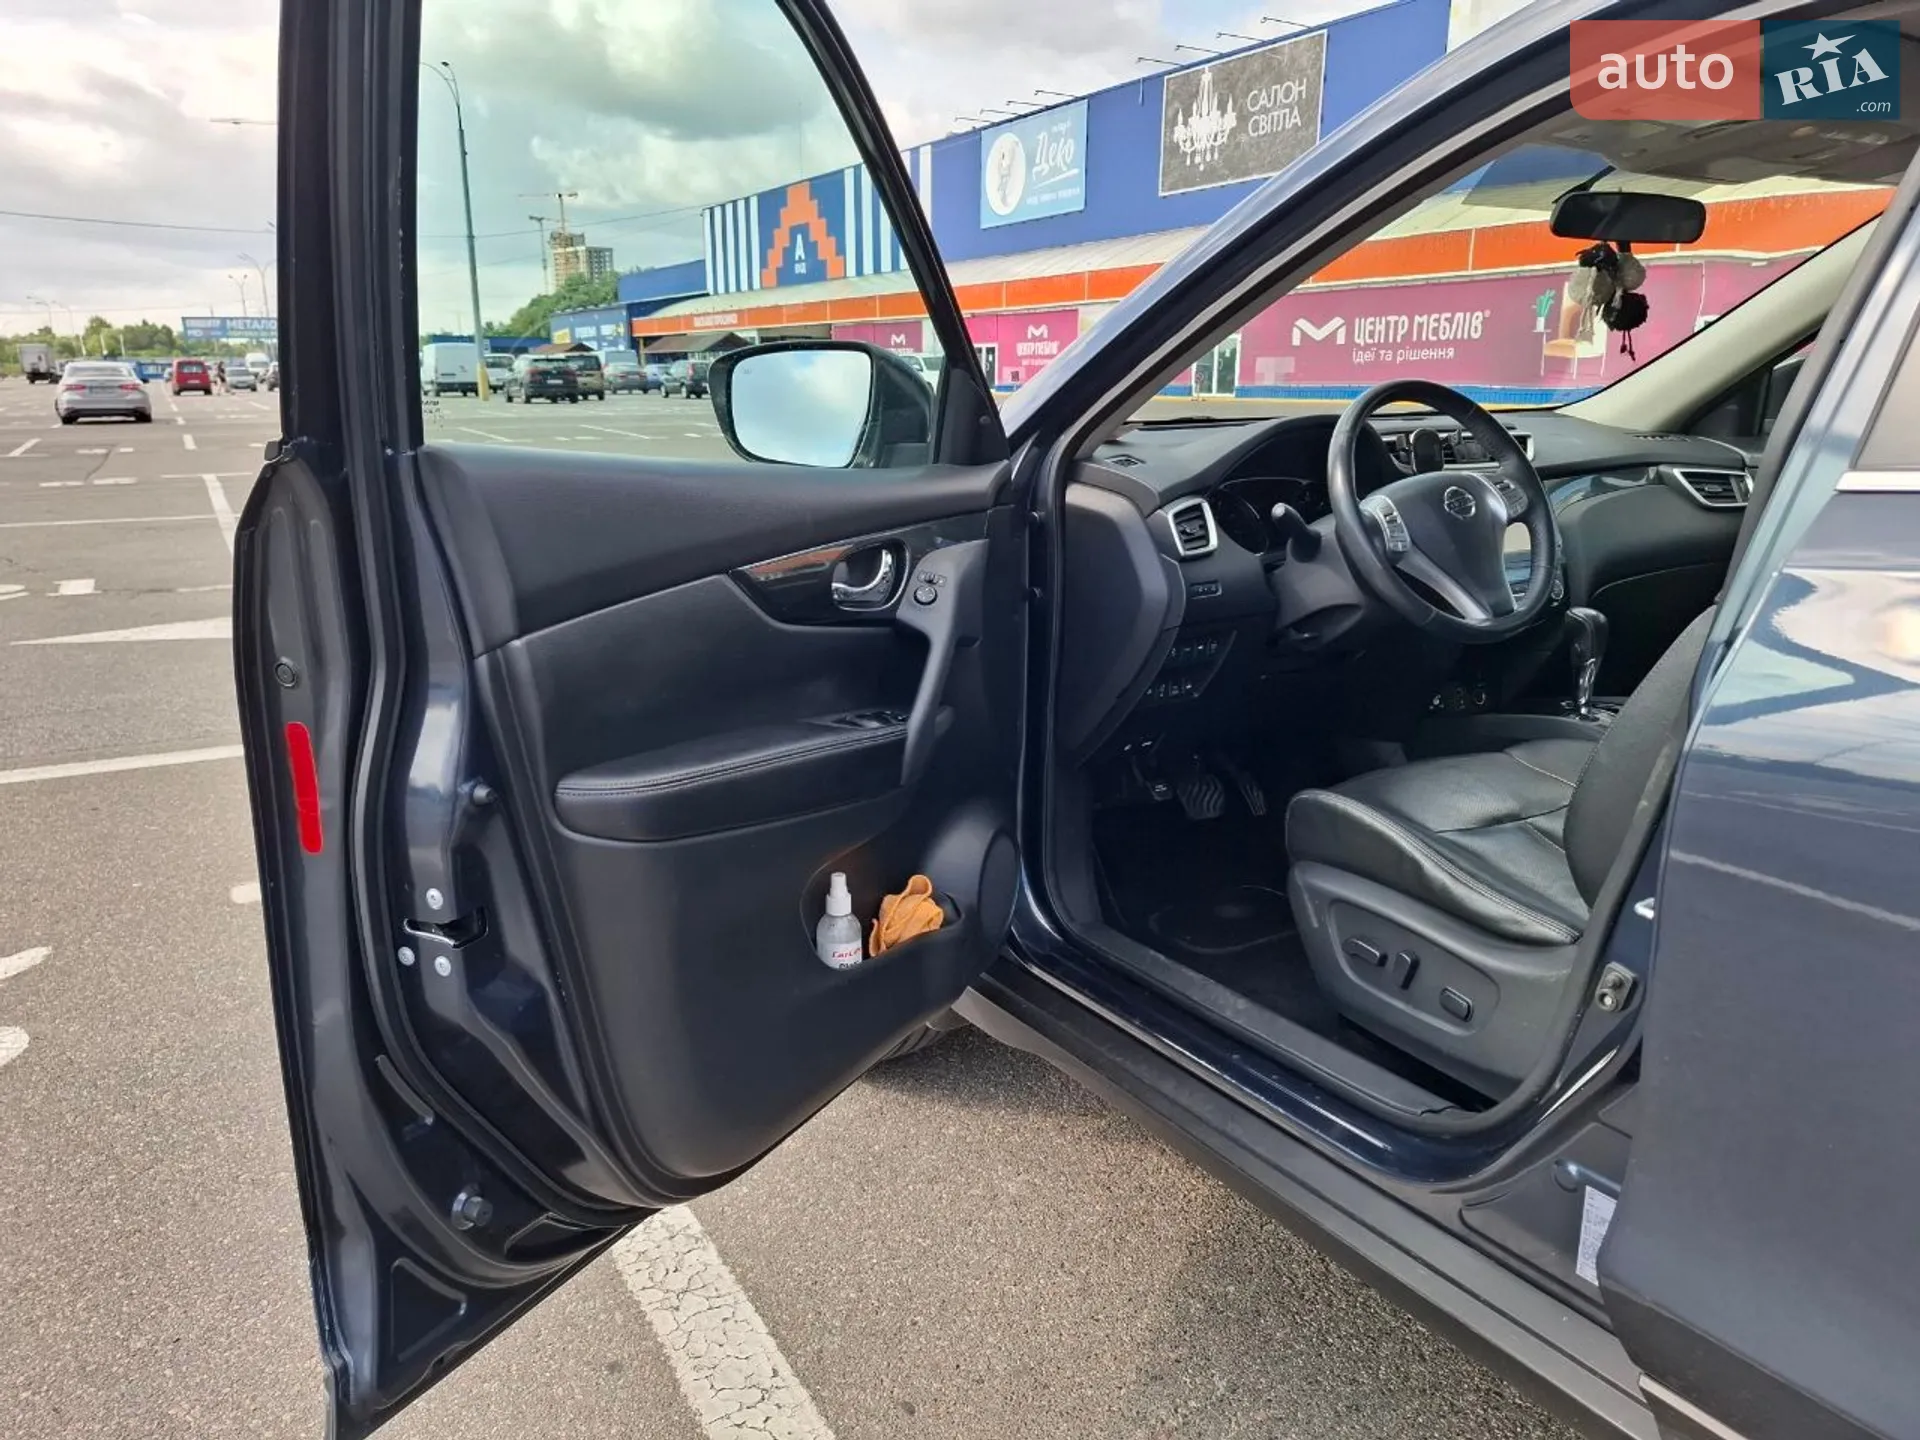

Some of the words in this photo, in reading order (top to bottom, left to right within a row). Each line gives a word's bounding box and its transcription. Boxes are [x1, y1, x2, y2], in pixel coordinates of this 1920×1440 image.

[1247, 77, 1307, 112] САЛОН
[1248, 105, 1302, 137] СВІТЛА
[1032, 131, 1075, 181] Деко
[1354, 314, 1410, 346] ЦЕНТР
[1352, 347, 1376, 365] ідеї
[1379, 349, 1393, 361] та
[1396, 346, 1455, 365] рішення
